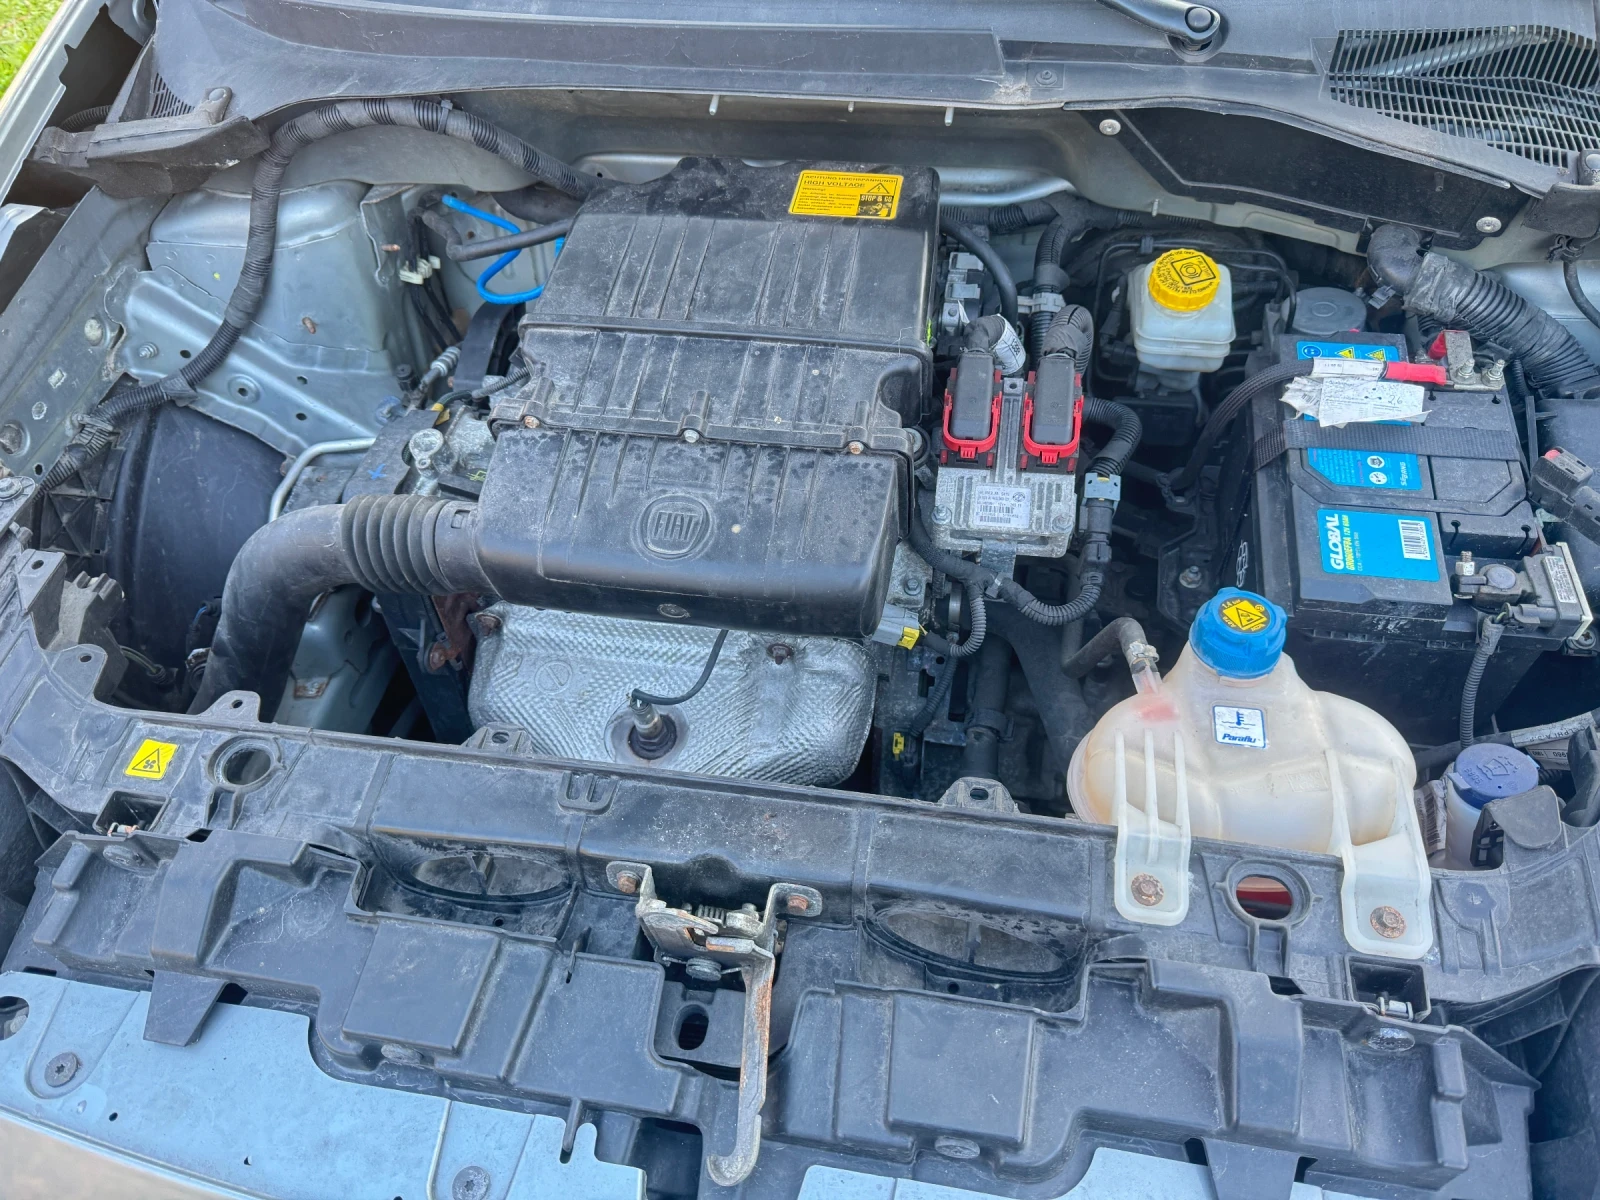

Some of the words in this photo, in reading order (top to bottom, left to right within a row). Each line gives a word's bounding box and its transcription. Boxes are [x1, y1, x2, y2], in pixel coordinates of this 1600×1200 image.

[651, 510, 698, 541] FIAT
[1343, 527, 1352, 536] 12V
[1326, 513, 1345, 570] GLOBAL
[1222, 732, 1257, 744] Paraflu
[1554, 725, 1586, 738] DELPHI
